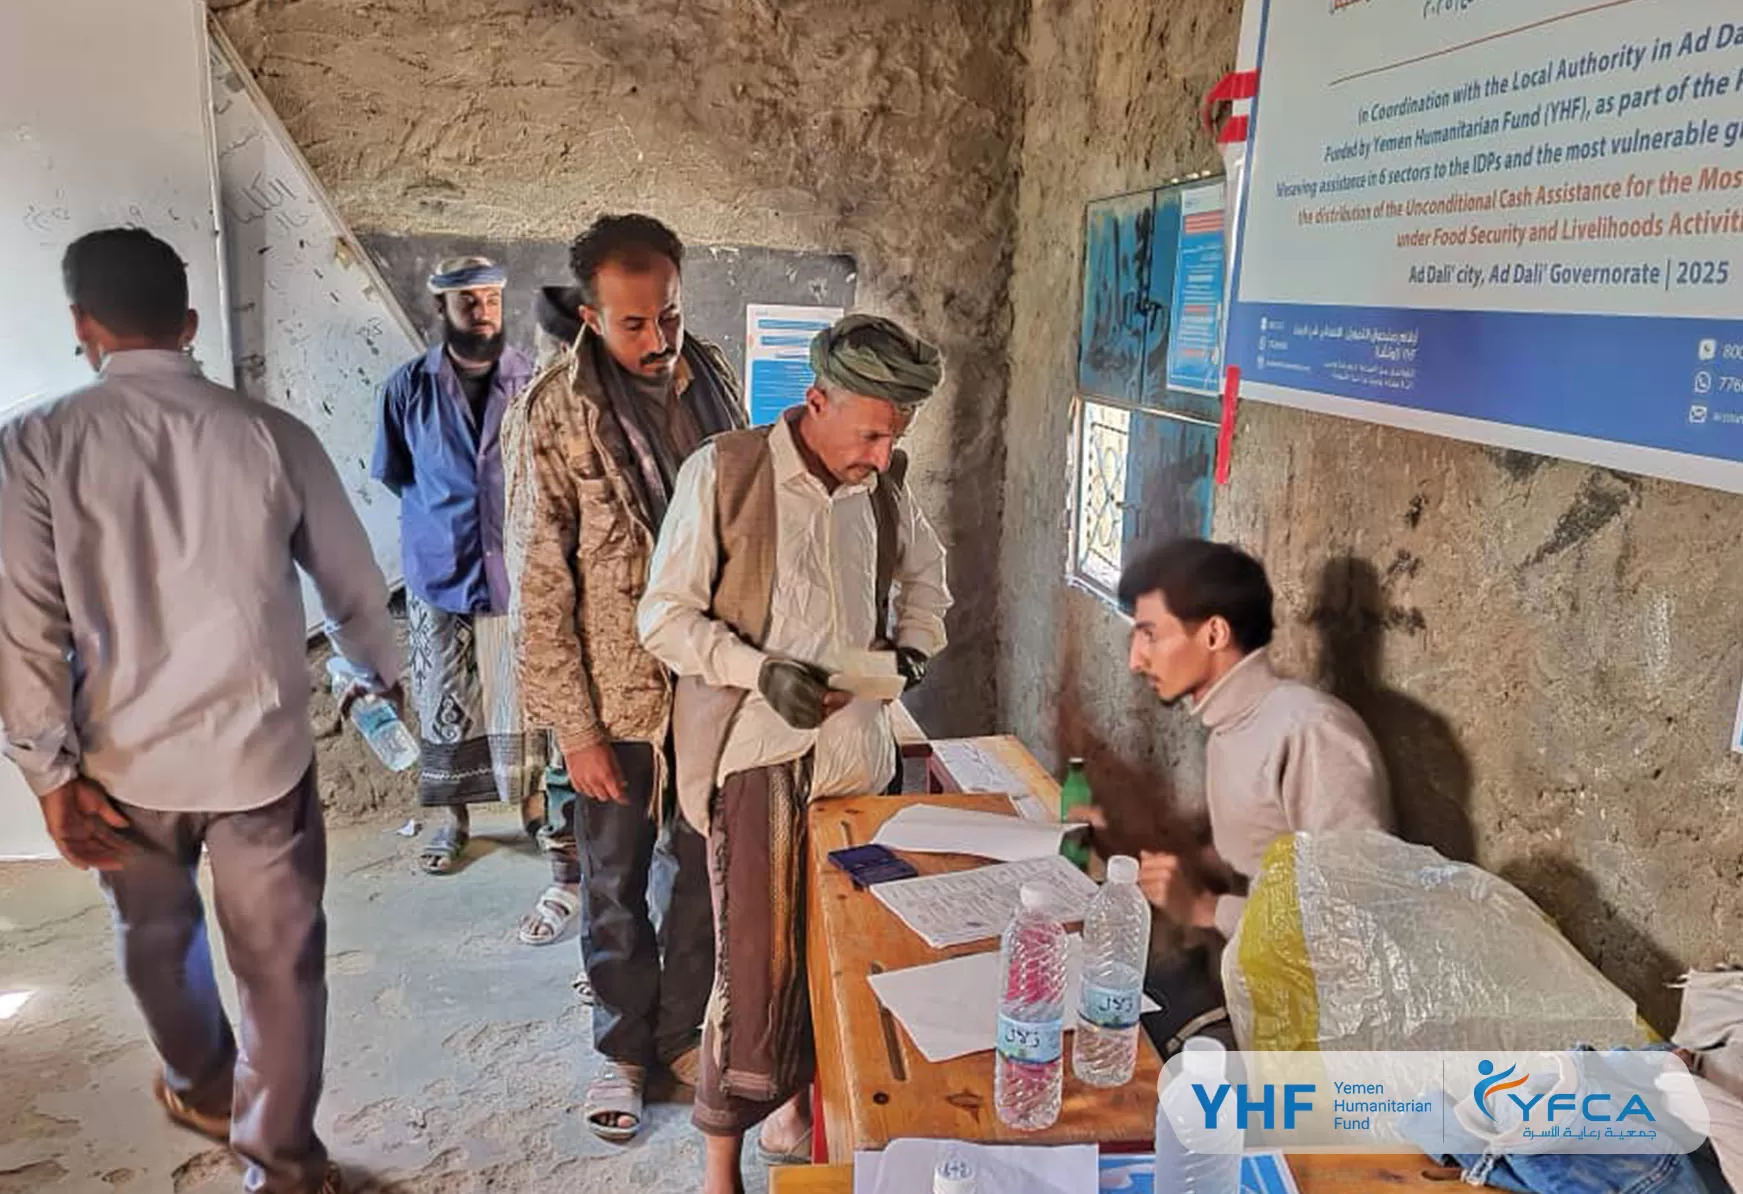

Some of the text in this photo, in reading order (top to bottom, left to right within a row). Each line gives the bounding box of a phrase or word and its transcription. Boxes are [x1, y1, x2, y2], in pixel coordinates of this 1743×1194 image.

[1371, 90, 1450, 122] Coordination
[1452, 81, 1481, 104] with
[1485, 75, 1508, 97] the
[1512, 61, 1553, 90] Local
[1556, 45, 1647, 81] Authority
[1651, 38, 1672, 61] in
[1677, 26, 1711, 56] Ad
[1359, 140, 1370, 159] by
[1373, 135, 1412, 154] Yemen
[1415, 117, 1499, 147] Humanitarian
[1502, 107, 1541, 132] Fund
[1544, 96, 1591, 127] (YHF),
[1595, 96, 1613, 115] as
[1617, 84, 1661, 116] part
[1665, 75, 1691, 103] of
[1693, 72, 1729, 99] the
[1319, 175, 1366, 193] assistance
[1367, 170, 1378, 187] in
[1378, 168, 1387, 185] 6
[1388, 164, 1432, 184] sectors
[1434, 163, 1448, 179] to
[1449, 157, 1470, 177] the
[1472, 152, 1502, 174] IDPs
[1504, 147, 1533, 169] and
[1536, 143, 1562, 166] the
[1565, 136, 1606, 160] most
[1611, 118, 1719, 155] vulnerable
[1298, 209, 1313, 226] the
[1315, 204, 1372, 225] distribution
[1372, 200, 1384, 220] of
[1385, 200, 1404, 217] the
[1406, 189, 1497, 217] Unconditional
[1499, 185, 1532, 209] Cash
[1535, 178, 1622, 207] Assistance
[1625, 173, 1656, 199] for
[1658, 169, 1692, 196] the
[1396, 229, 1431, 248] under
[1432, 224, 1468, 246] Food
[1469, 222, 1528, 247] Security
[1529, 219, 1557, 243] and
[1561, 211, 1664, 241] Livelihoods
[1408, 265, 1426, 284] Ad
[1456, 264, 1485, 288] city,
[1488, 263, 1511, 284] Ad
[1549, 261, 1661, 285] Governorate
[1676, 260, 1730, 285] 2025
